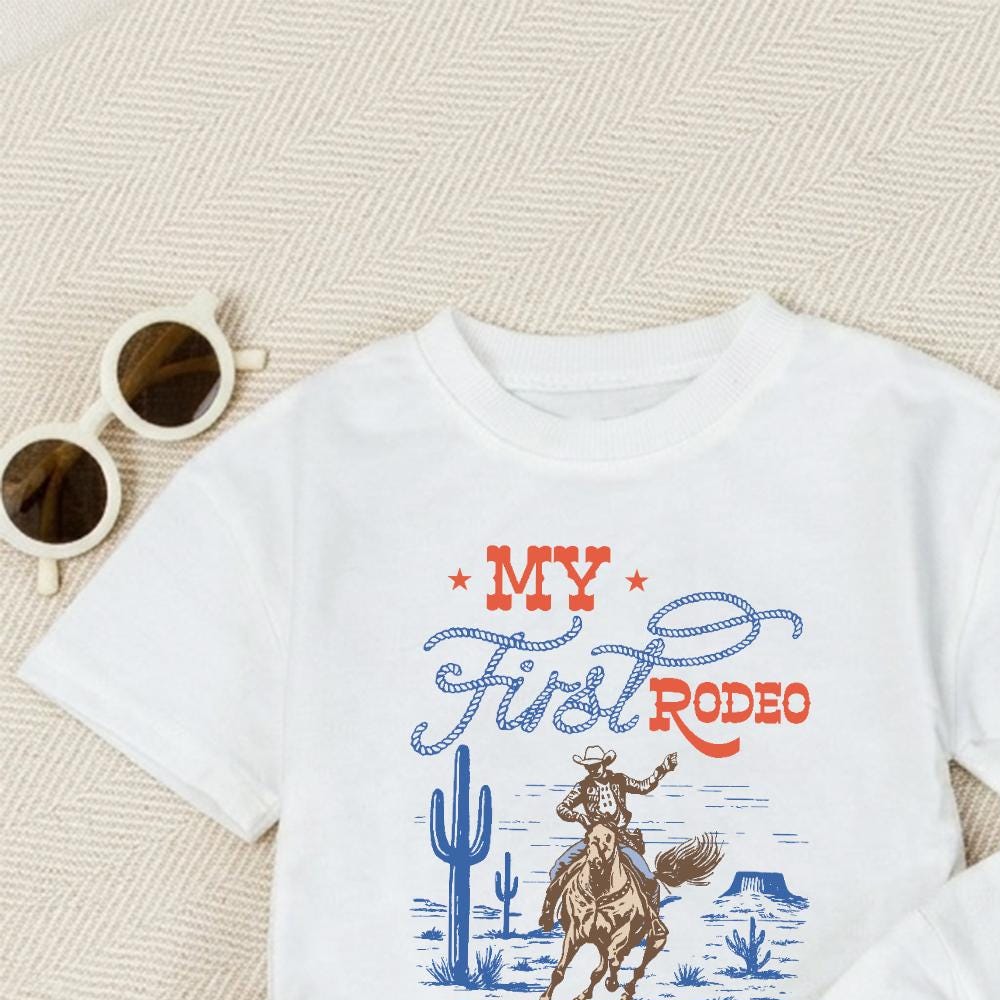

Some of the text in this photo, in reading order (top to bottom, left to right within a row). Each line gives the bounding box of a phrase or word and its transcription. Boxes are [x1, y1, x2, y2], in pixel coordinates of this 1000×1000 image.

[486, 545, 611, 612] MY
[410, 591, 811, 758] First RODEO
